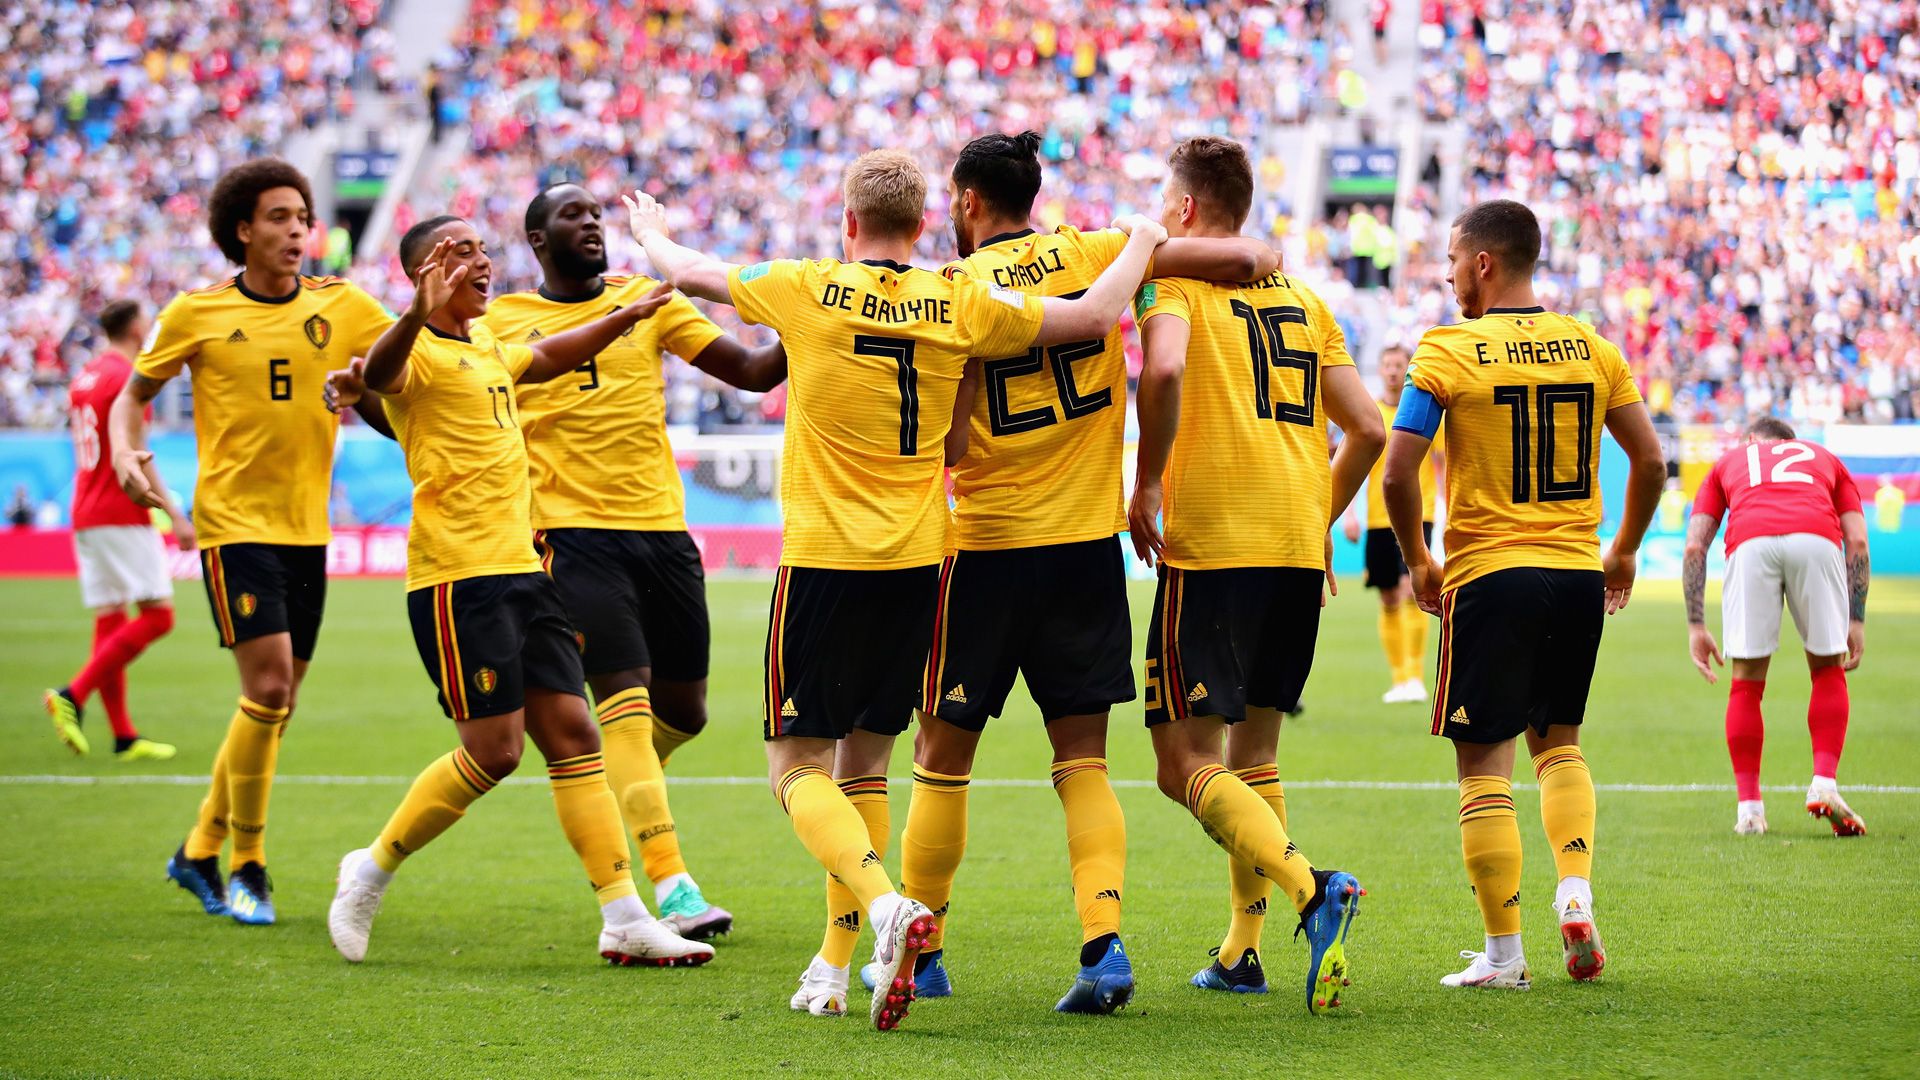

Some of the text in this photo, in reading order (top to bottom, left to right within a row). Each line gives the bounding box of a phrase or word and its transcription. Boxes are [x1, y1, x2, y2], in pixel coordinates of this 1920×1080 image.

[993, 248, 1065, 287] CHADLI
[822, 284, 952, 324] DE BRUYNE
[1230, 299, 1317, 427] 15
[1476, 339, 1590, 365] E. HAZARD
[270, 359, 292, 400] 6
[854, 334, 919, 456] 7
[1494, 383, 1594, 504] 10
[1747, 442, 1815, 487] 12
[946, 694, 967, 704] adidas
[1450, 716, 1470, 725] adidas
[1561, 846, 1590, 855] adidas
[833, 920, 861, 933] adidas
